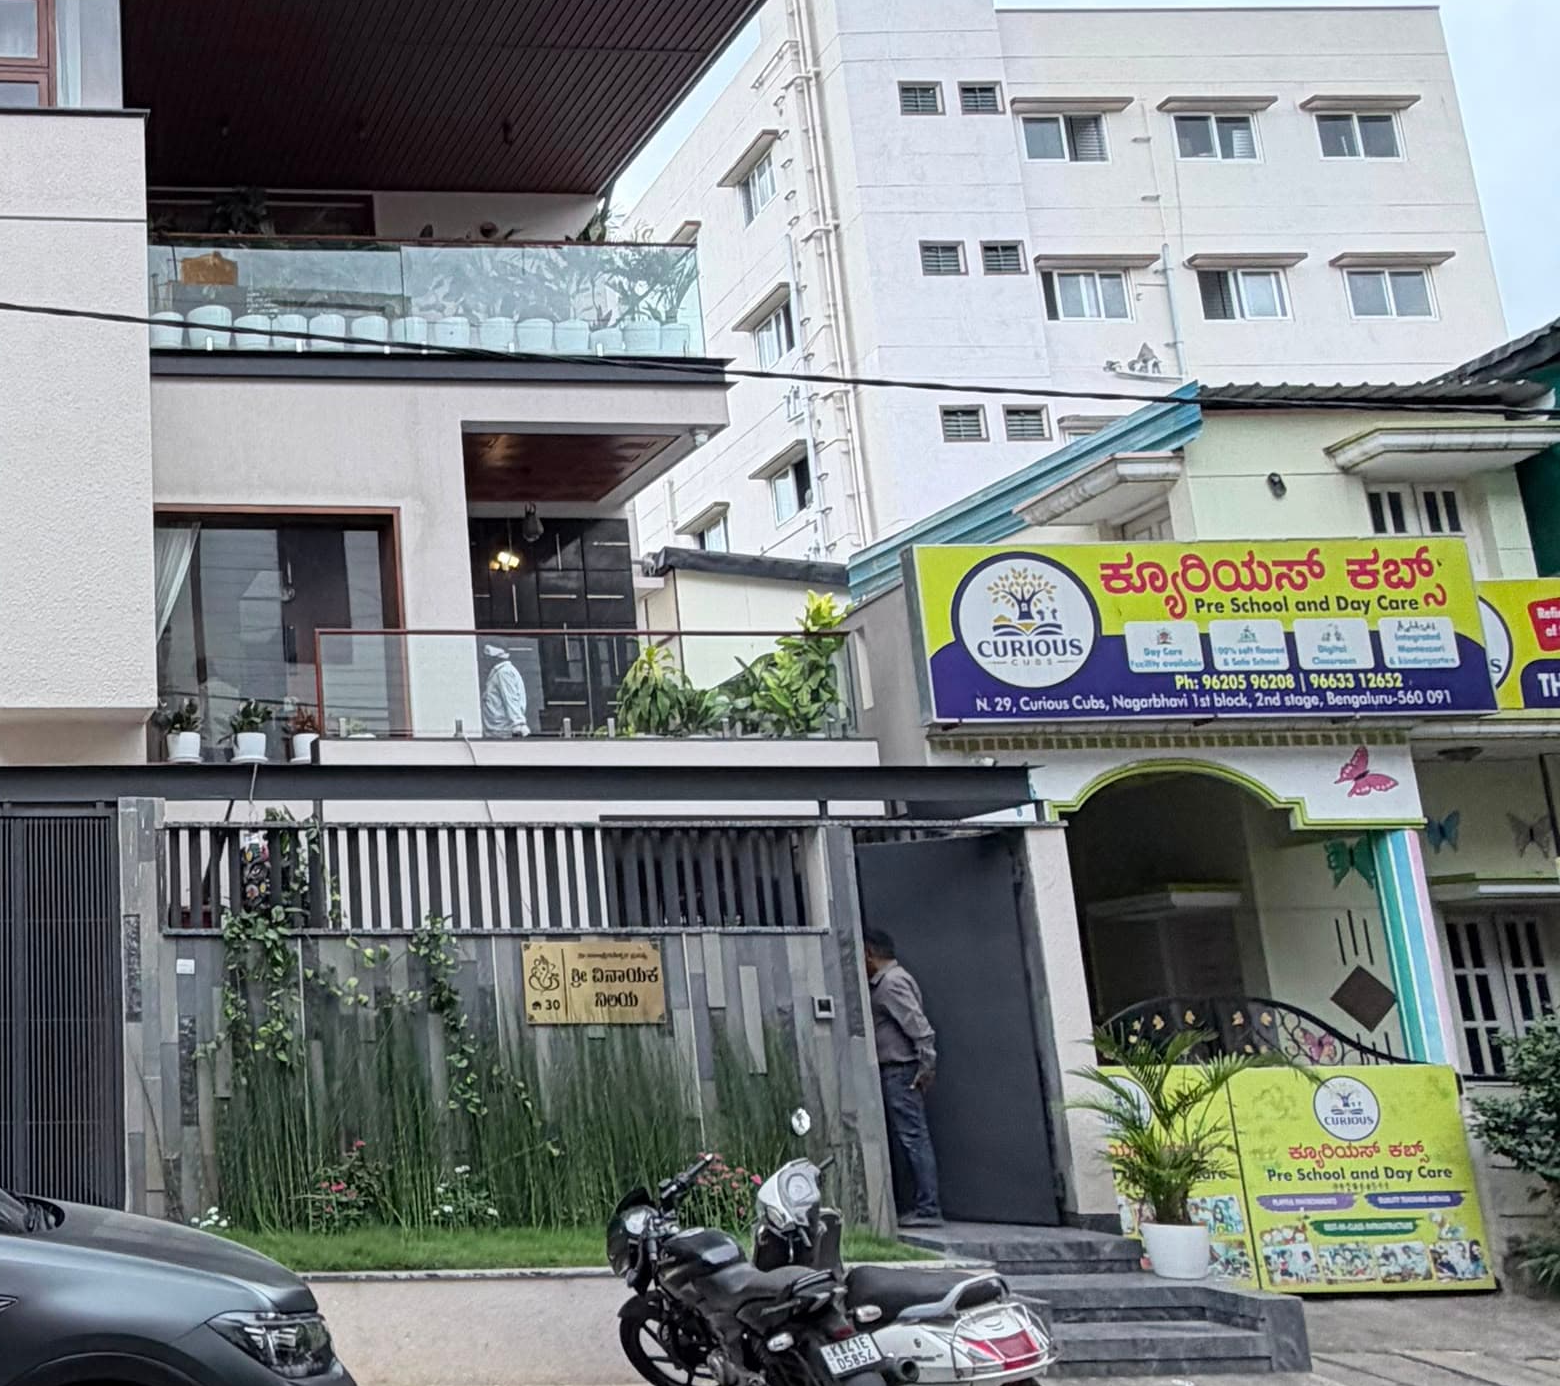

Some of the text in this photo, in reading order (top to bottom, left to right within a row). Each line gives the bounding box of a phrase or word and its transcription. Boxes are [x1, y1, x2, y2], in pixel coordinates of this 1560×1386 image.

[1100, 546, 1448, 620] ಕ್ಯೂರಿಯಸ್ ಕಬ್ಸ್
[1194, 595, 1419, 615] Pre School and Day Care
[977, 638, 1084, 658] CURIOUS
[1010, 658, 1053, 667] CUBS
[1174, 675, 1199, 690] Ph:
[1202, 674, 1247, 690] 96205
[1250, 673, 1295, 690] 96208
[1310, 672, 1355, 689] 96633
[1359, 672, 1404, 688] 12652
[994, 696, 1017, 714] 29,
[1020, 696, 1070, 711] Curious
[1072, 694, 1110, 712] Cubs,
[1112, 694, 1188, 712] Nagarbhavi
[1192, 693, 1211, 708] 1st
[1214, 693, 1253, 709] block,
[1255, 692, 1281, 707] 2nd
[1284, 692, 1324, 709] stage,
[1426, 689, 1452, 705] 091
[545, 999, 561, 1011] 30
[1323, 1116, 1374, 1126] CURIOUS
[1267, 1165, 1453, 1182] Pre School and Day Care
